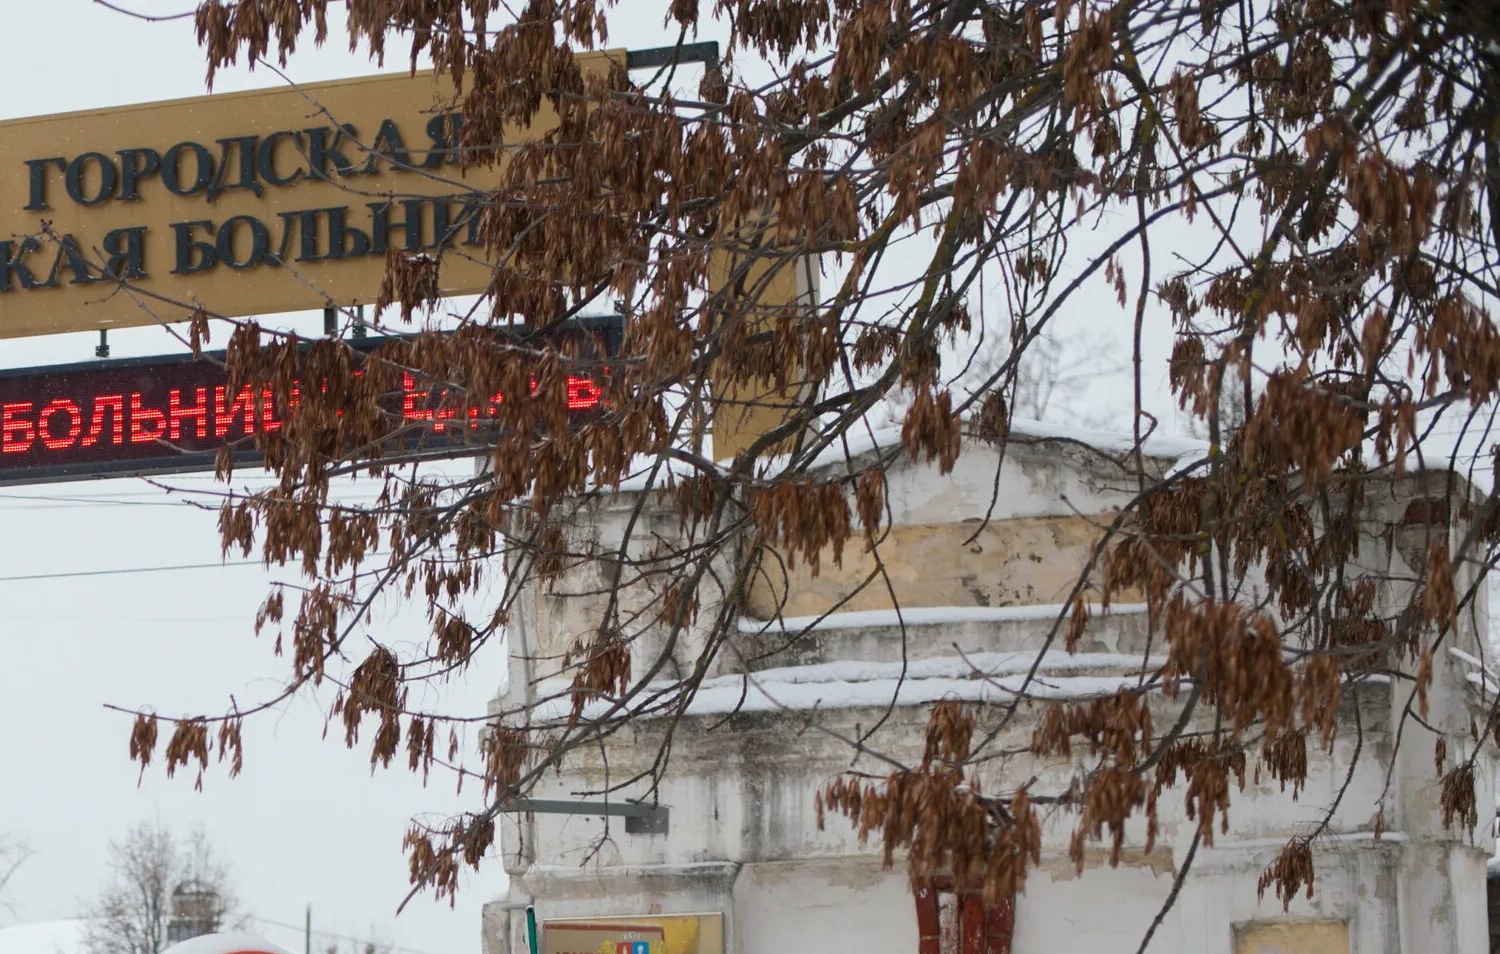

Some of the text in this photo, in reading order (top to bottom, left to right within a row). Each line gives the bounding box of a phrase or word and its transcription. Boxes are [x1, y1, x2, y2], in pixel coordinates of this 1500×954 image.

[23, 111, 466, 211] ГОРОДСКАЯ
[169, 197, 488, 275] БОЛЬНИ
[2, 378, 320, 454] БОЛЬНИЦ
